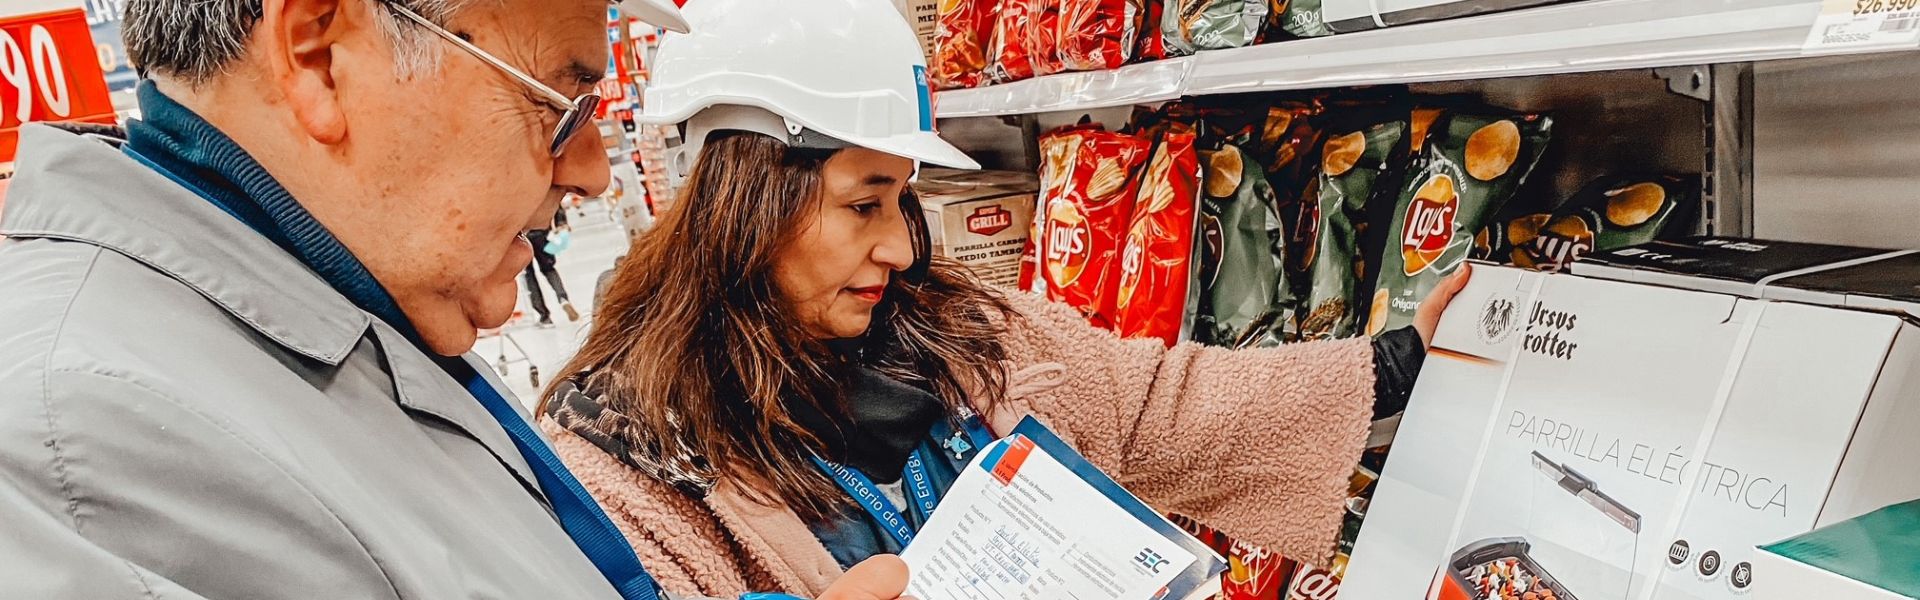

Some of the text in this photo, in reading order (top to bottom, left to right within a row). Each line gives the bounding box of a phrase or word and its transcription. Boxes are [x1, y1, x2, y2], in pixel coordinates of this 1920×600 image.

[0, 23, 70, 124] 90
[970, 213, 1009, 230] GRILL
[1404, 200, 1452, 251] Lay's
[954, 242, 994, 253] PARRILLA
[1049, 220, 1085, 268] Lay's
[1529, 300, 1577, 331] Ursus
[1523, 330, 1577, 360] rotter
[1506, 410, 1621, 468] PARRILLA
[907, 455, 930, 499] Energ
[882, 510, 898, 528] de
